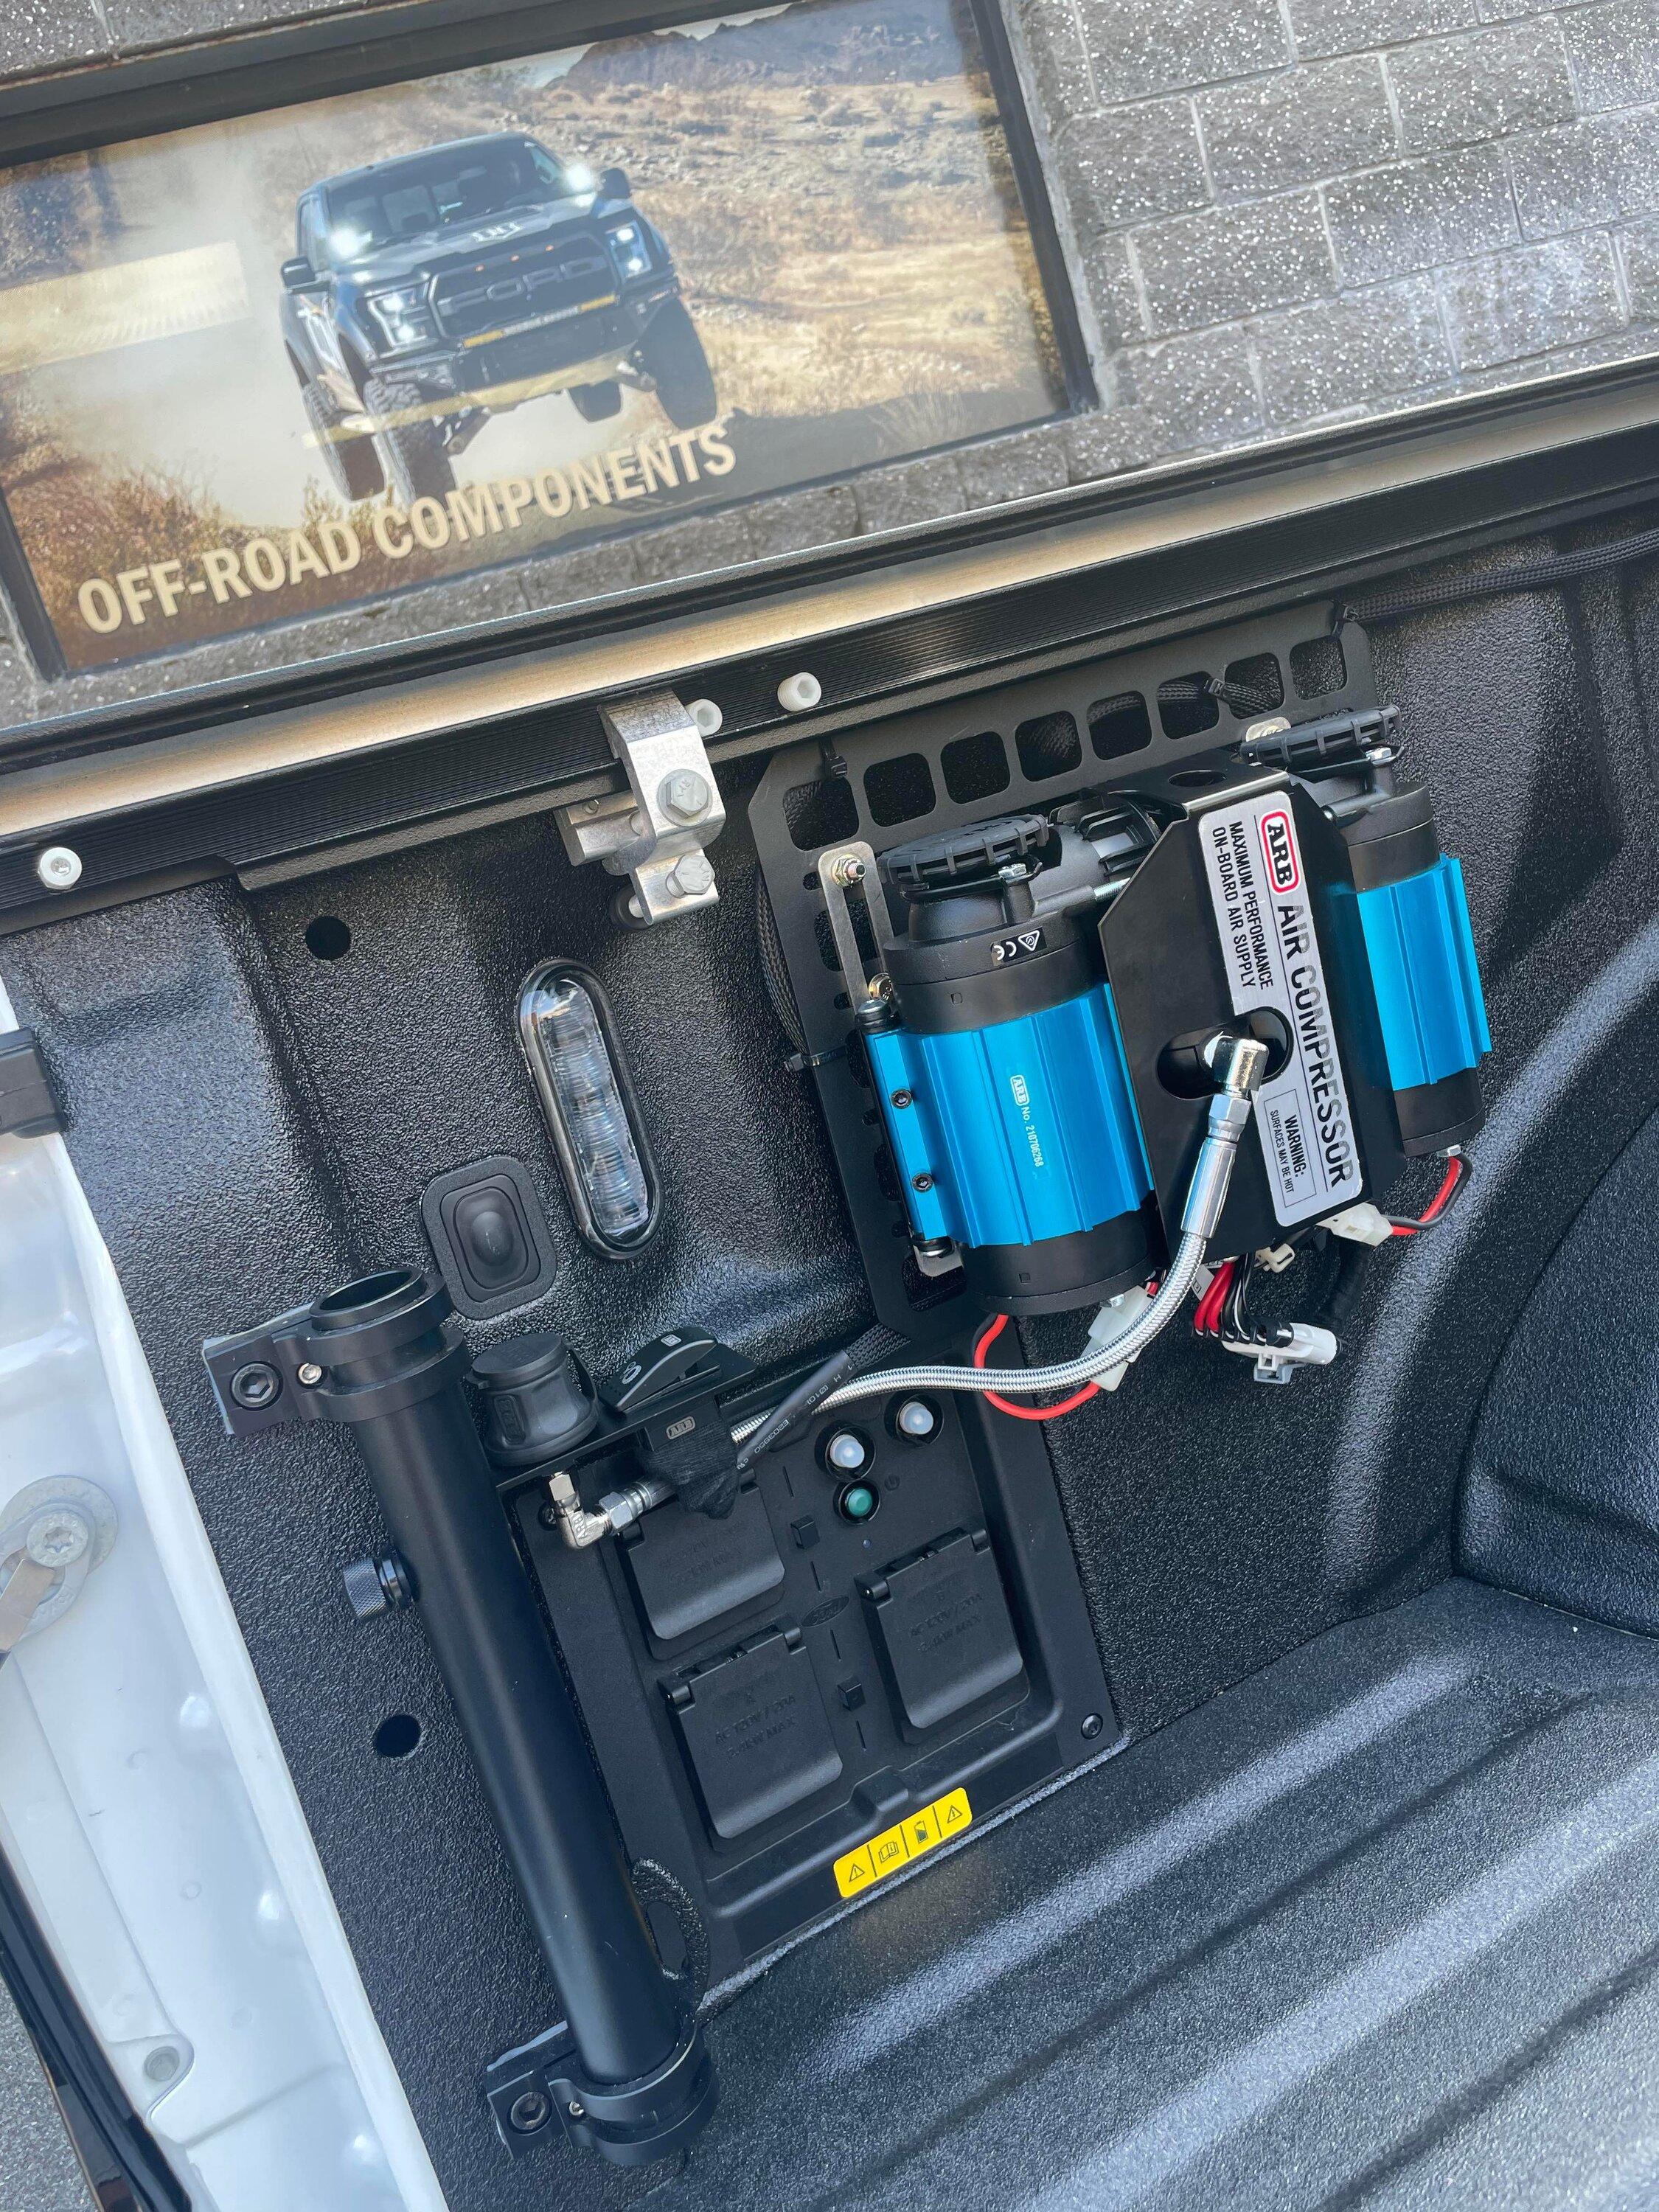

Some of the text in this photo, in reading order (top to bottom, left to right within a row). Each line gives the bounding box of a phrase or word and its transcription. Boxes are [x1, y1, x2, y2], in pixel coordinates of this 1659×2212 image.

[438, 256, 609, 317] FORD
[77, 425, 737, 633] OFF-ROAD COMPONENTS
[1212, 827, 1256, 987] ON-BOARD AIR SUPPLY
[1228, 821, 1273, 990] MAXIMUM PERFORMANCE
[1265, 821, 1354, 1187] ARB AIR COMPRESSOR
[1021, 1106, 1031, 1123] No.
[1270, 1109, 1294, 1193] SURFACES MAY BE HOT
[1284, 1114, 1307, 1178] WARNING:
[668, 1418, 694, 1438] ARB
